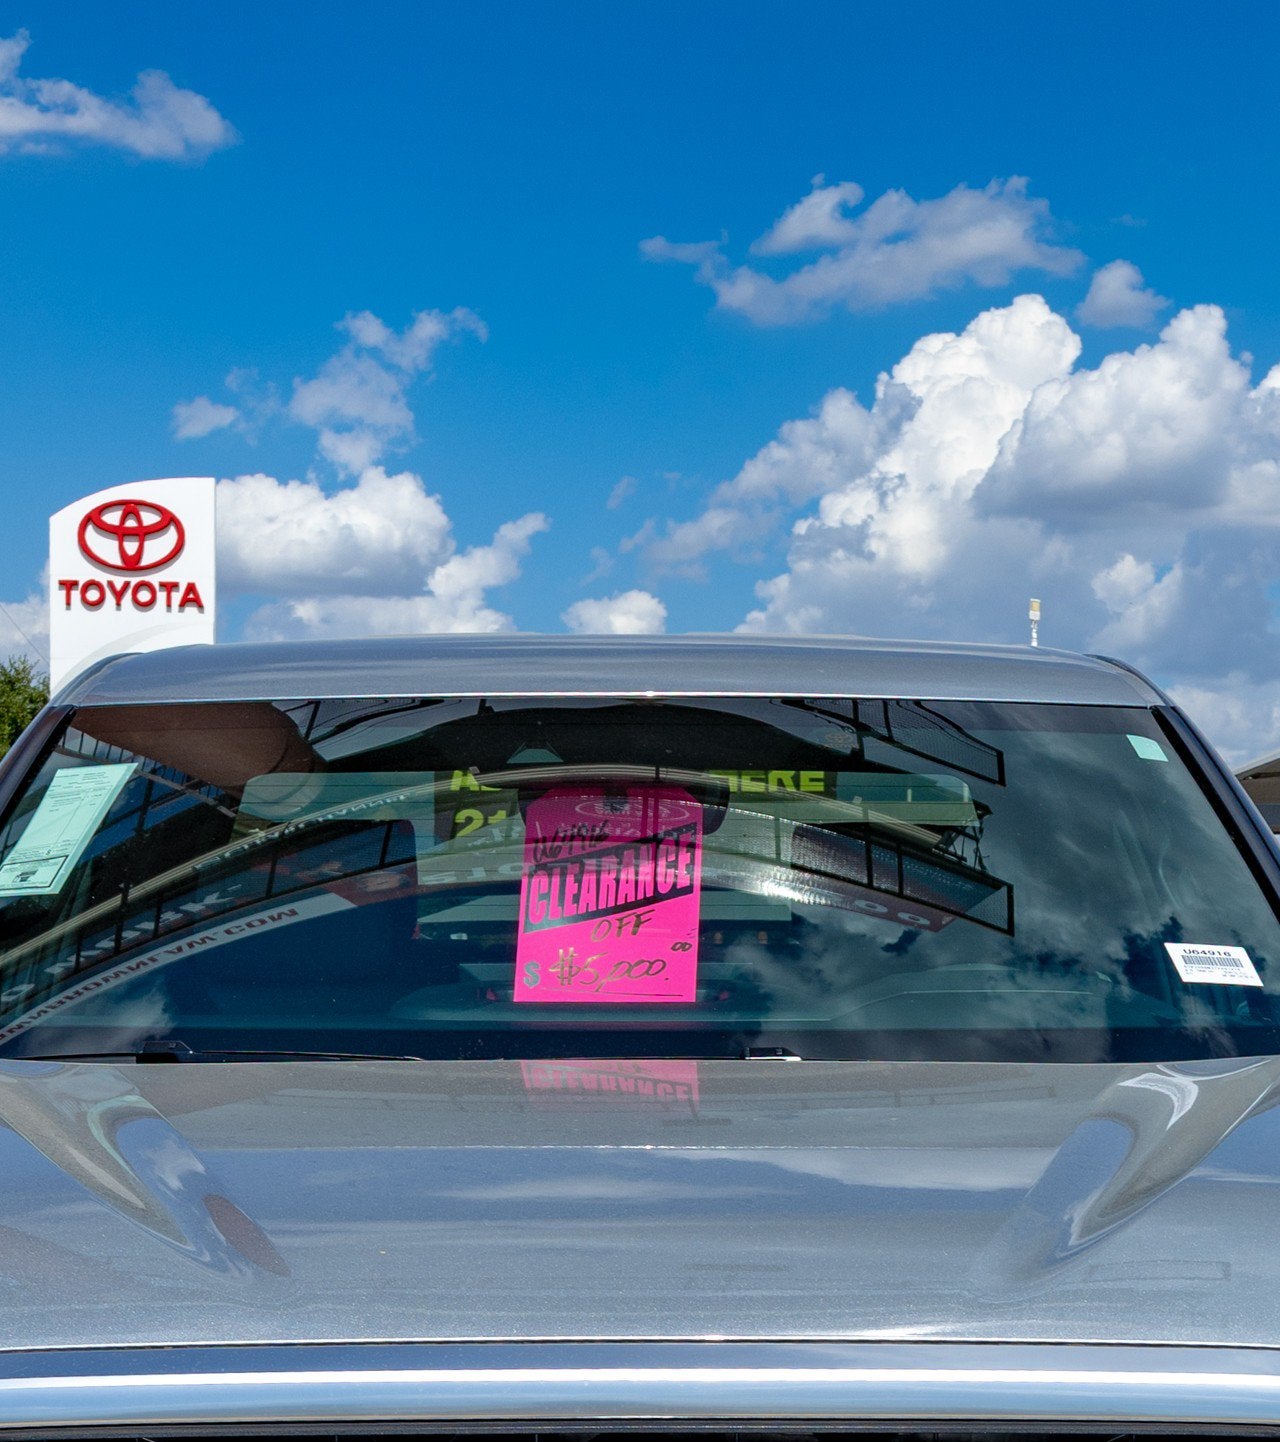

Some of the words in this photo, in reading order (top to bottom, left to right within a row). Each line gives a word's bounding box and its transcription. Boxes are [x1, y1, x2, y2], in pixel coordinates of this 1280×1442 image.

[58, 579, 205, 613] TOYOTA
[528, 832, 695, 925] CLEARANCE
[590, 909, 656, 942] OFF
[1183, 948, 1232, 957] U64916
